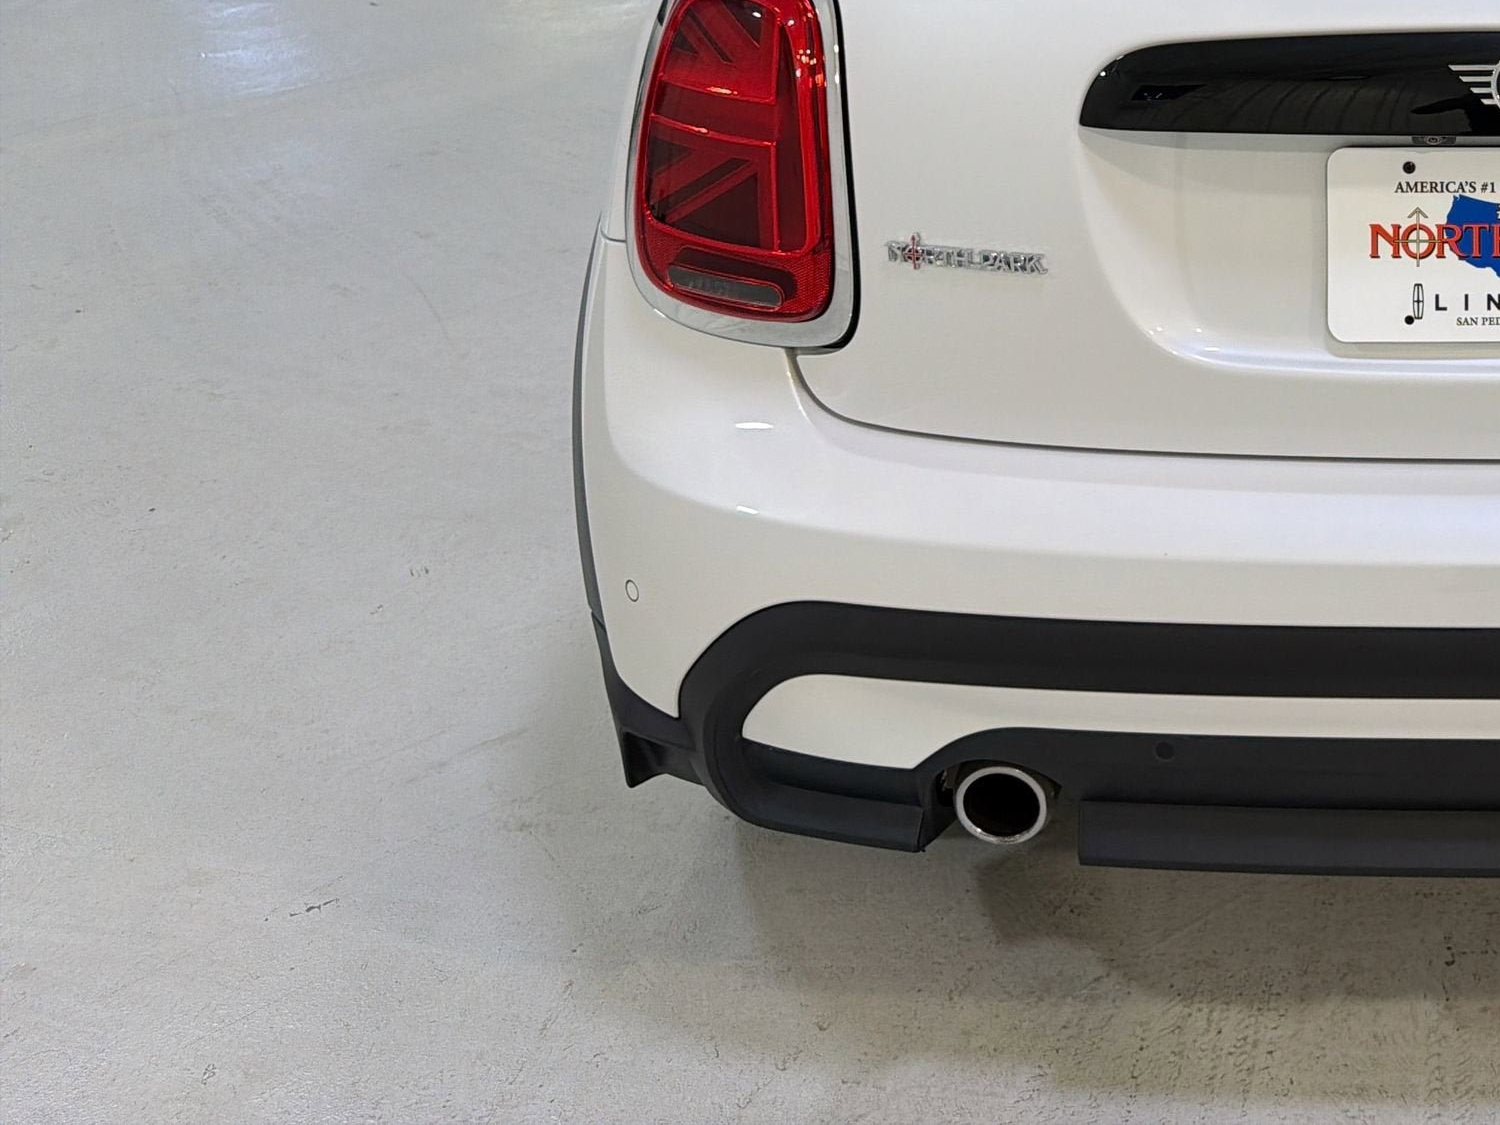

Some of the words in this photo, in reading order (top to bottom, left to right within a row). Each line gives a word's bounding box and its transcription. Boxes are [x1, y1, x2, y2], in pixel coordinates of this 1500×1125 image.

[1394, 180, 1477, 194] AMERICA'S
[1480, 180, 1497, 194] #1
[885, 240, 974, 269] NORTH
[977, 249, 1049, 275] PARK
[1455, 316, 1479, 327] SAN
